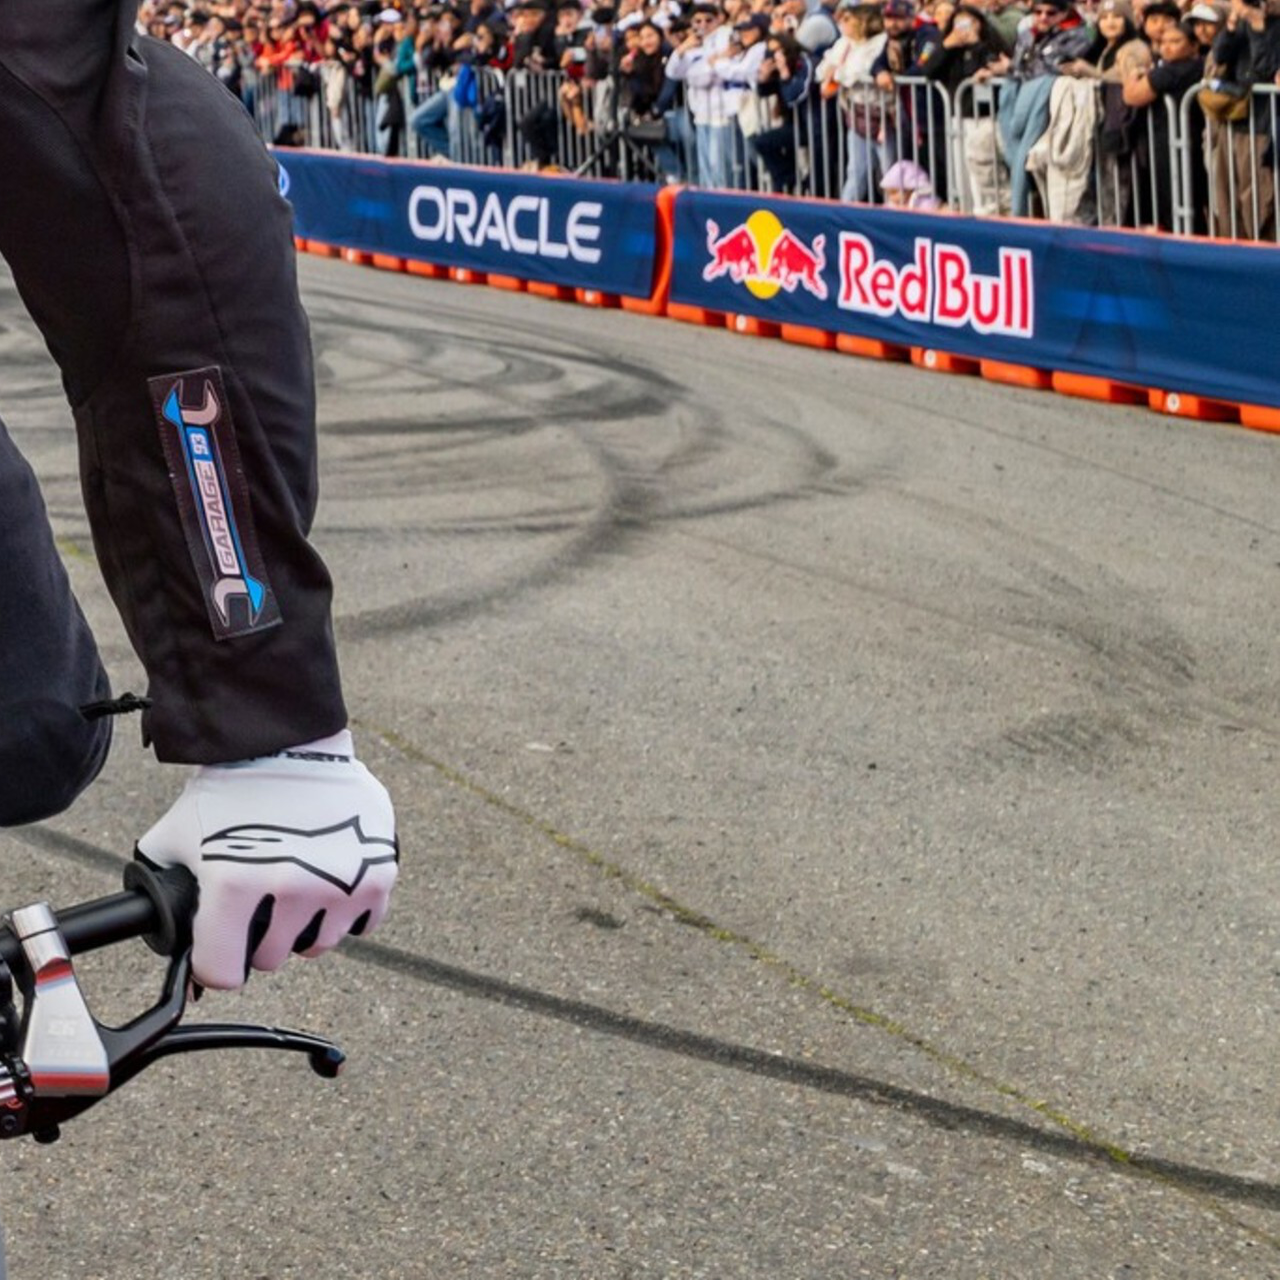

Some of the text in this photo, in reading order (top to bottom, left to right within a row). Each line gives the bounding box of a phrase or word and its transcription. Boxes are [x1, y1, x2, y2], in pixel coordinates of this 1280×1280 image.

[408, 186, 603, 263] ORACLE
[838, 231, 1035, 338] Red Bull
[196, 462, 236, 570] GARAGE
